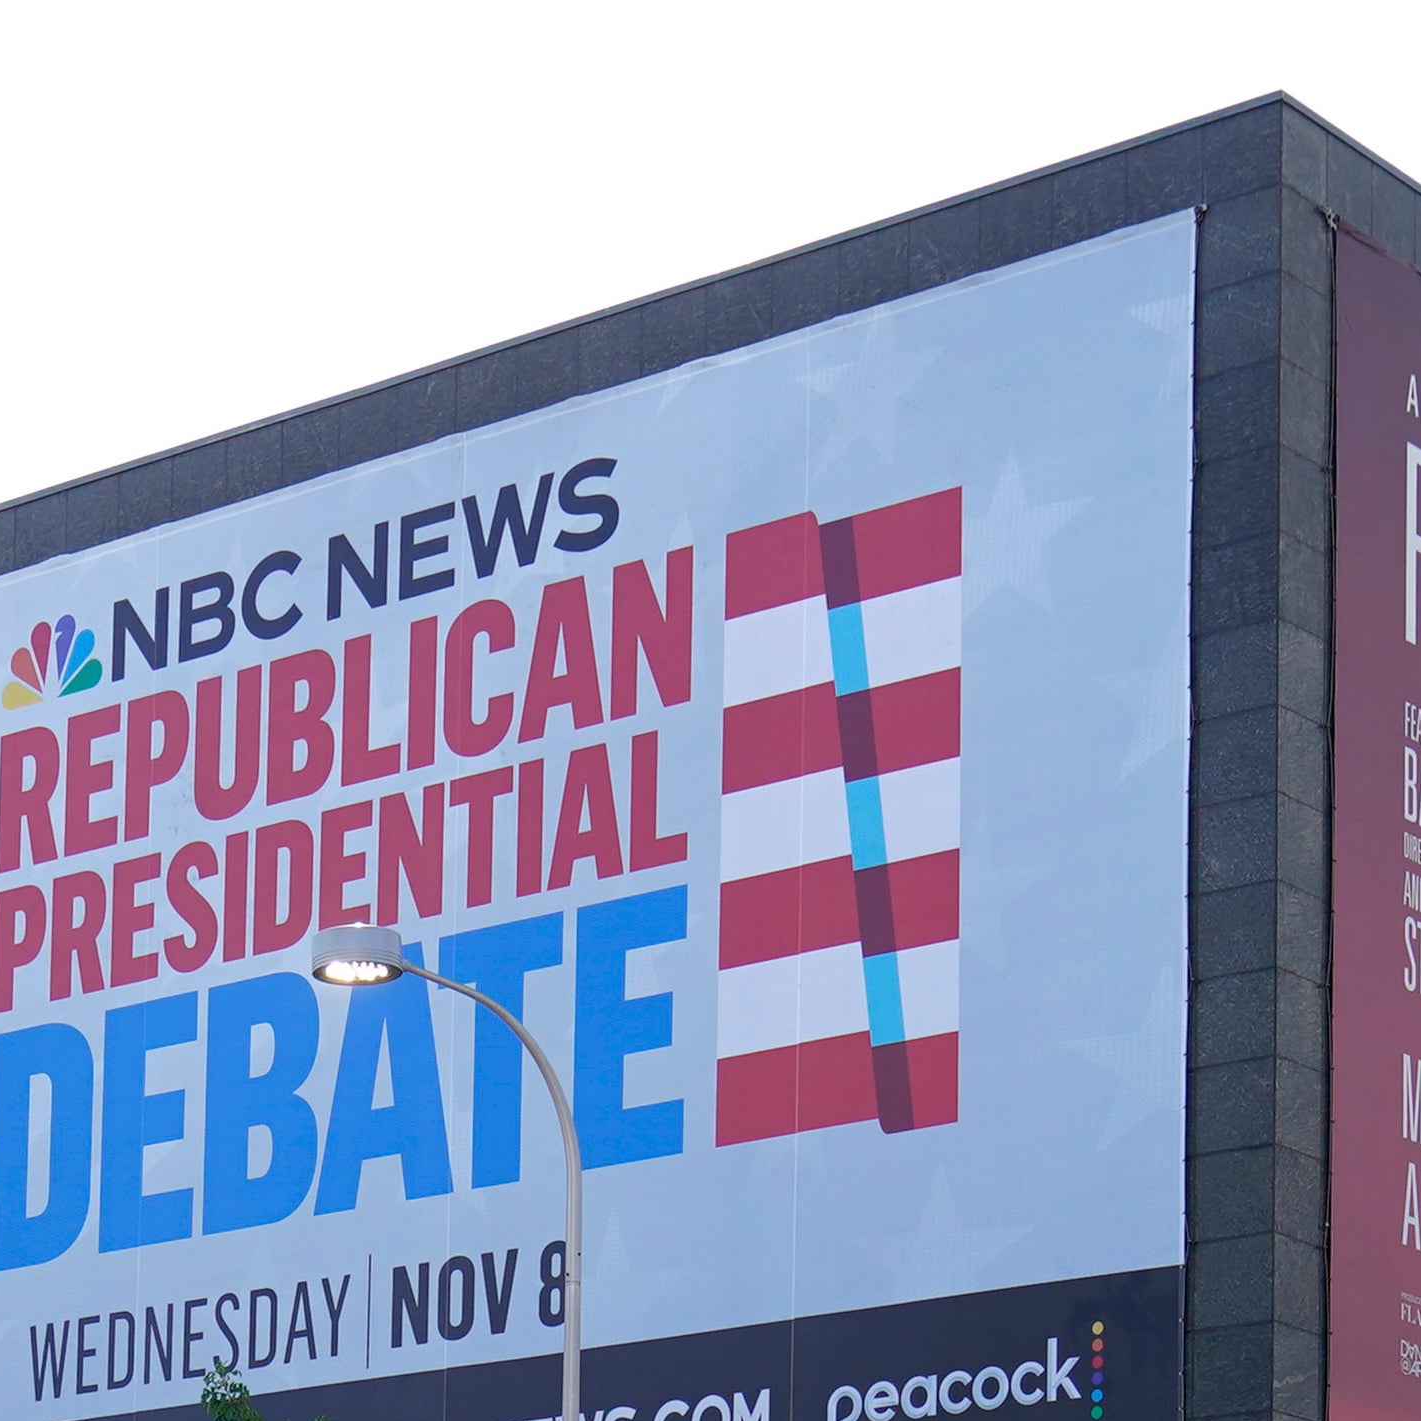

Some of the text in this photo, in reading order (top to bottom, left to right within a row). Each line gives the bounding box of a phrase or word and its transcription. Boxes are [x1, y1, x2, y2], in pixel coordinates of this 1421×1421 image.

[112, 457, 621, 682] NBC NEWS
[30, 1240, 567, 1402] WEDNESDAY NOV 8
